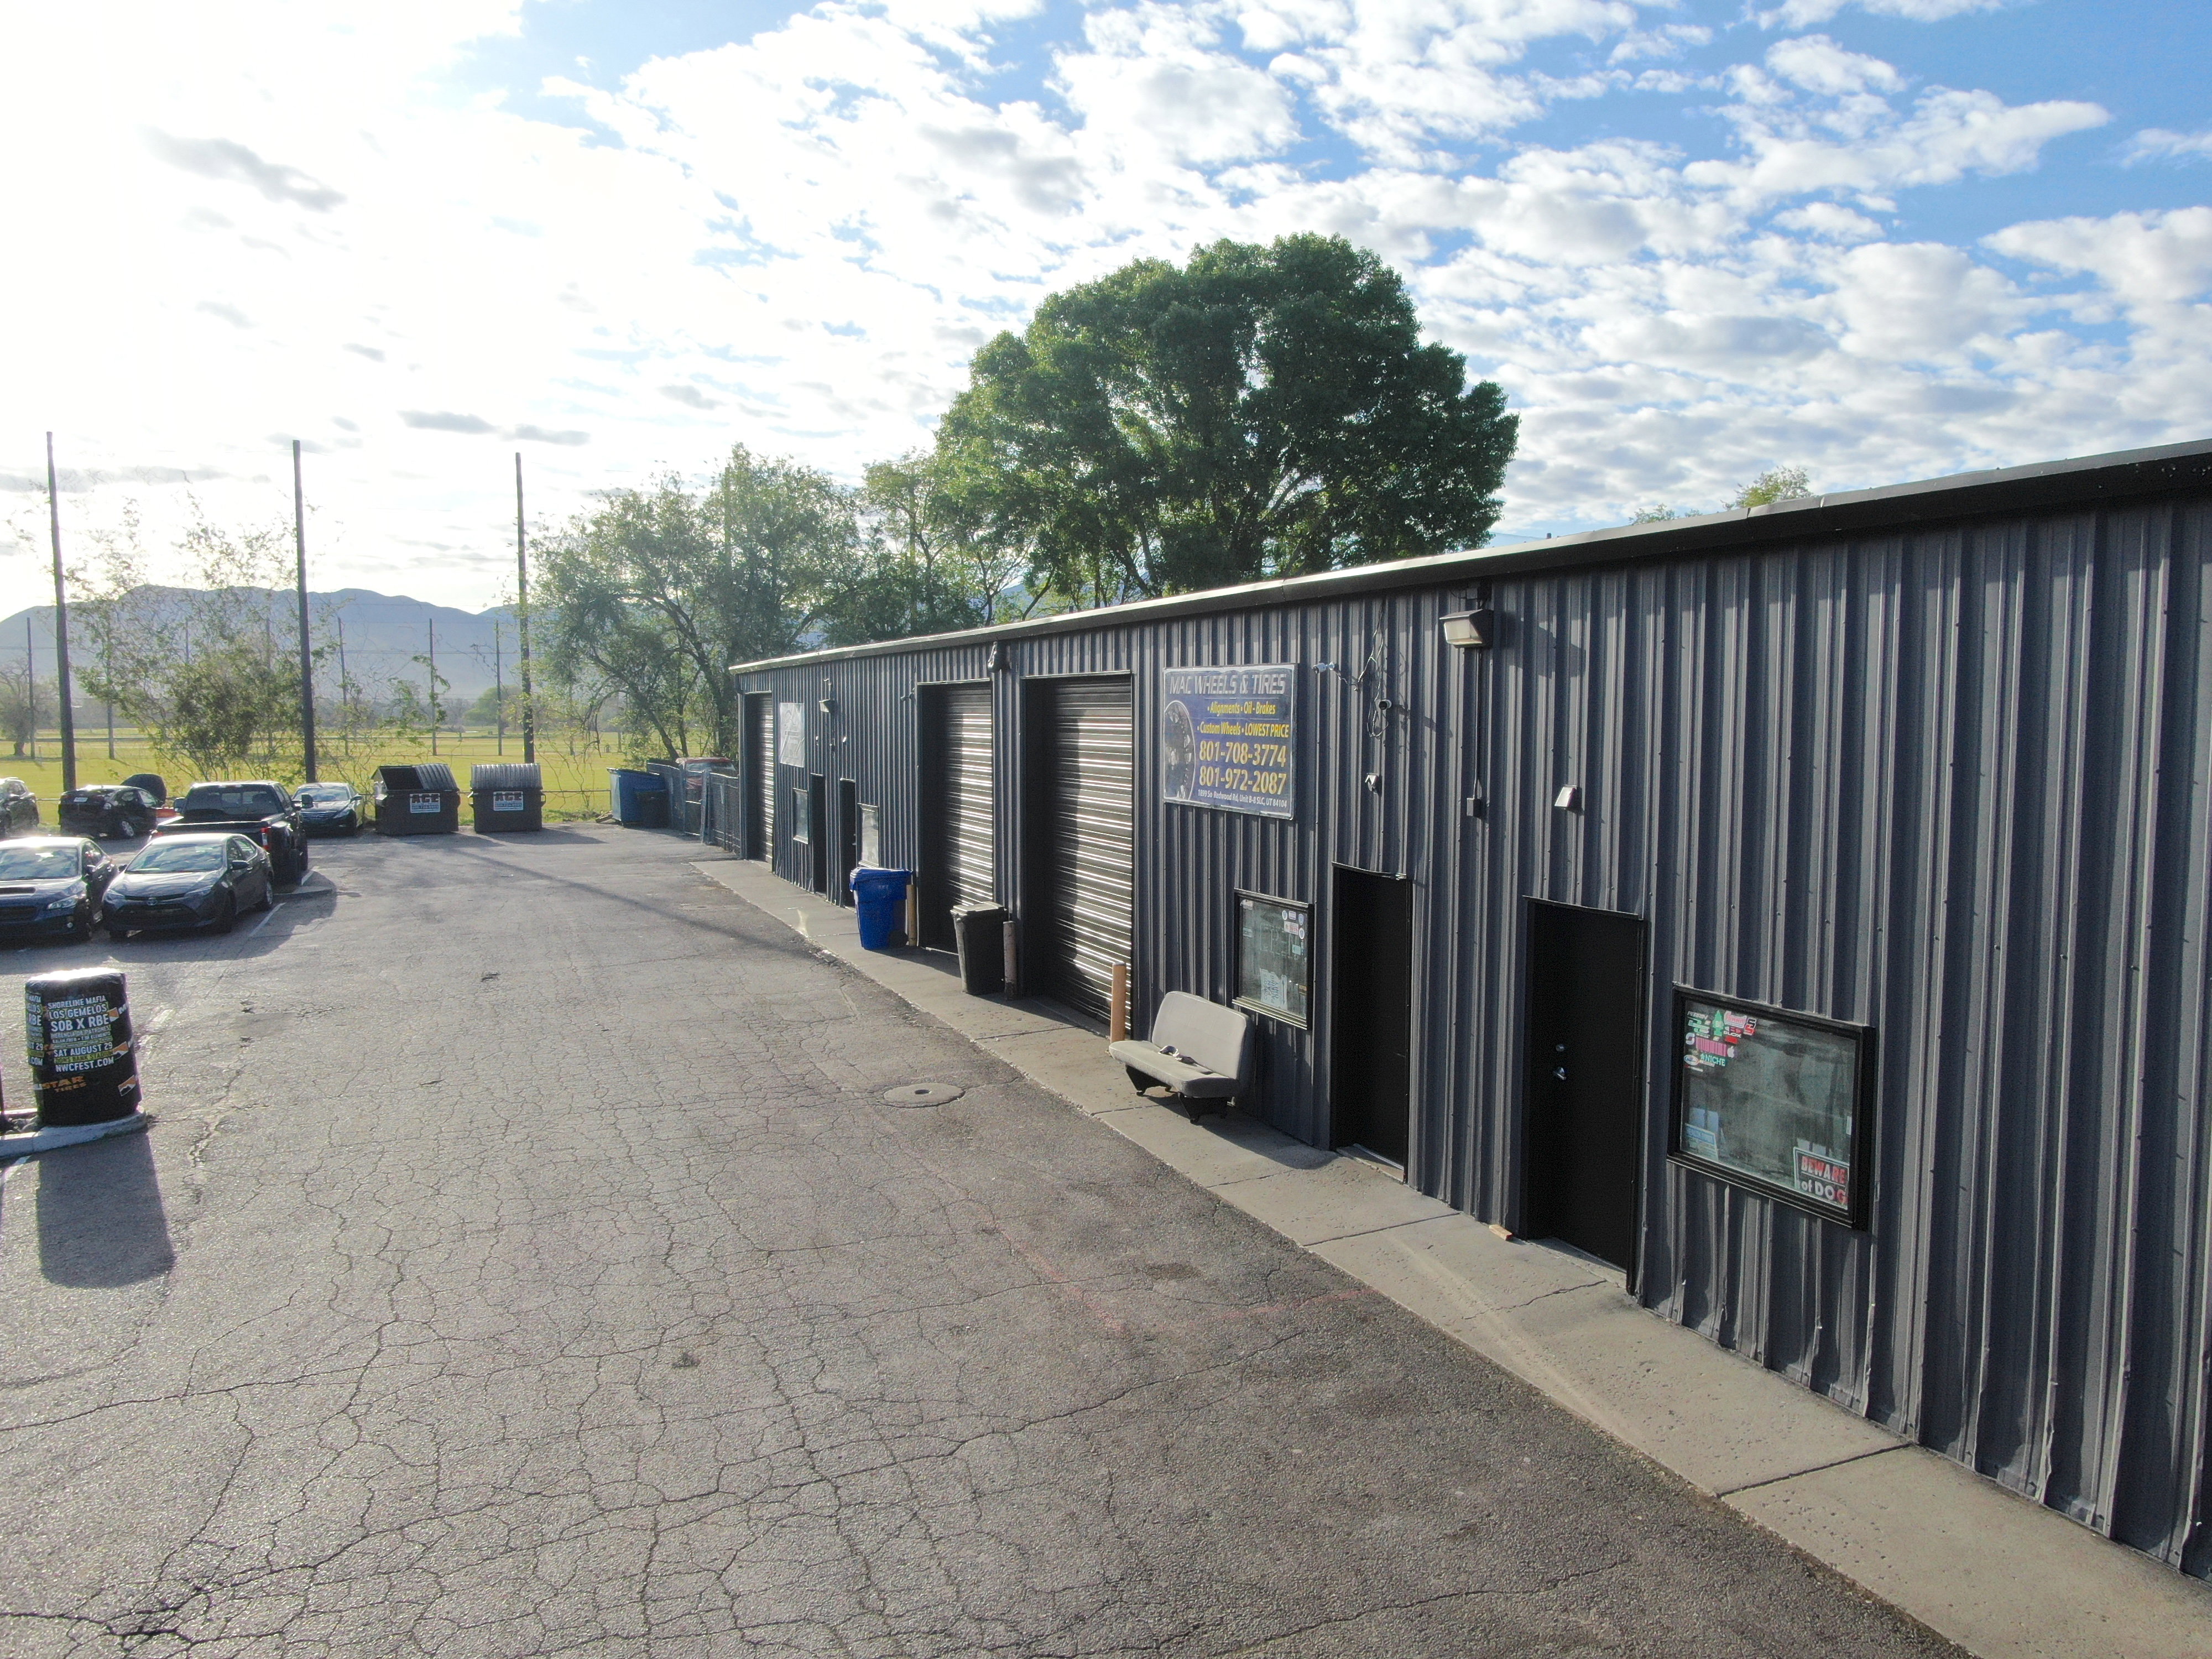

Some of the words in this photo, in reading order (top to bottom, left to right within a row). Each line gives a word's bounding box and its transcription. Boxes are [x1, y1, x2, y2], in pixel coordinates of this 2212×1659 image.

[1170, 676, 1192, 695] MAC
[1194, 675, 1238, 695] WHEELS
[1240, 674, 1249, 695] &
[1251, 674, 1287, 695] TIRES
[1209, 701, 1240, 716] Alignments
[1244, 701, 1252, 713] Oil
[1256, 701, 1275, 714] Brakes
[1199, 721, 1220, 734] Custom
[1221, 721, 1240, 735] Wheels
[1245, 723, 1271, 737] LOWEST
[1271, 723, 1289, 738] PRICE
[1199, 740, 1286, 768] 801-708-3774
[1199, 765, 1287, 795] 801-972-2087
[1266, 797, 1273, 806] UT
[1272, 799, 1287, 808] 84104
[48, 999, 84, 1009] SHORELINE
[49, 1010, 65, 1020] LOS
[67, 1004, 107, 1018] GEMELOS
[50, 1020, 73, 1032] SOB
[76, 1018, 86, 1030] X
[88, 1014, 109, 1028] RBE
[54, 1049, 67, 1057] SAT
[70, 1044, 102, 1056] AUGUST
[104, 1042, 113, 1051] 29
[55, 1056, 114, 1072] NWCFEST.COM
[1801, 1155, 1846, 1184] BEWARE
[1801, 1178, 1813, 1192] of
[1814, 1181, 1848, 1204] DOG
